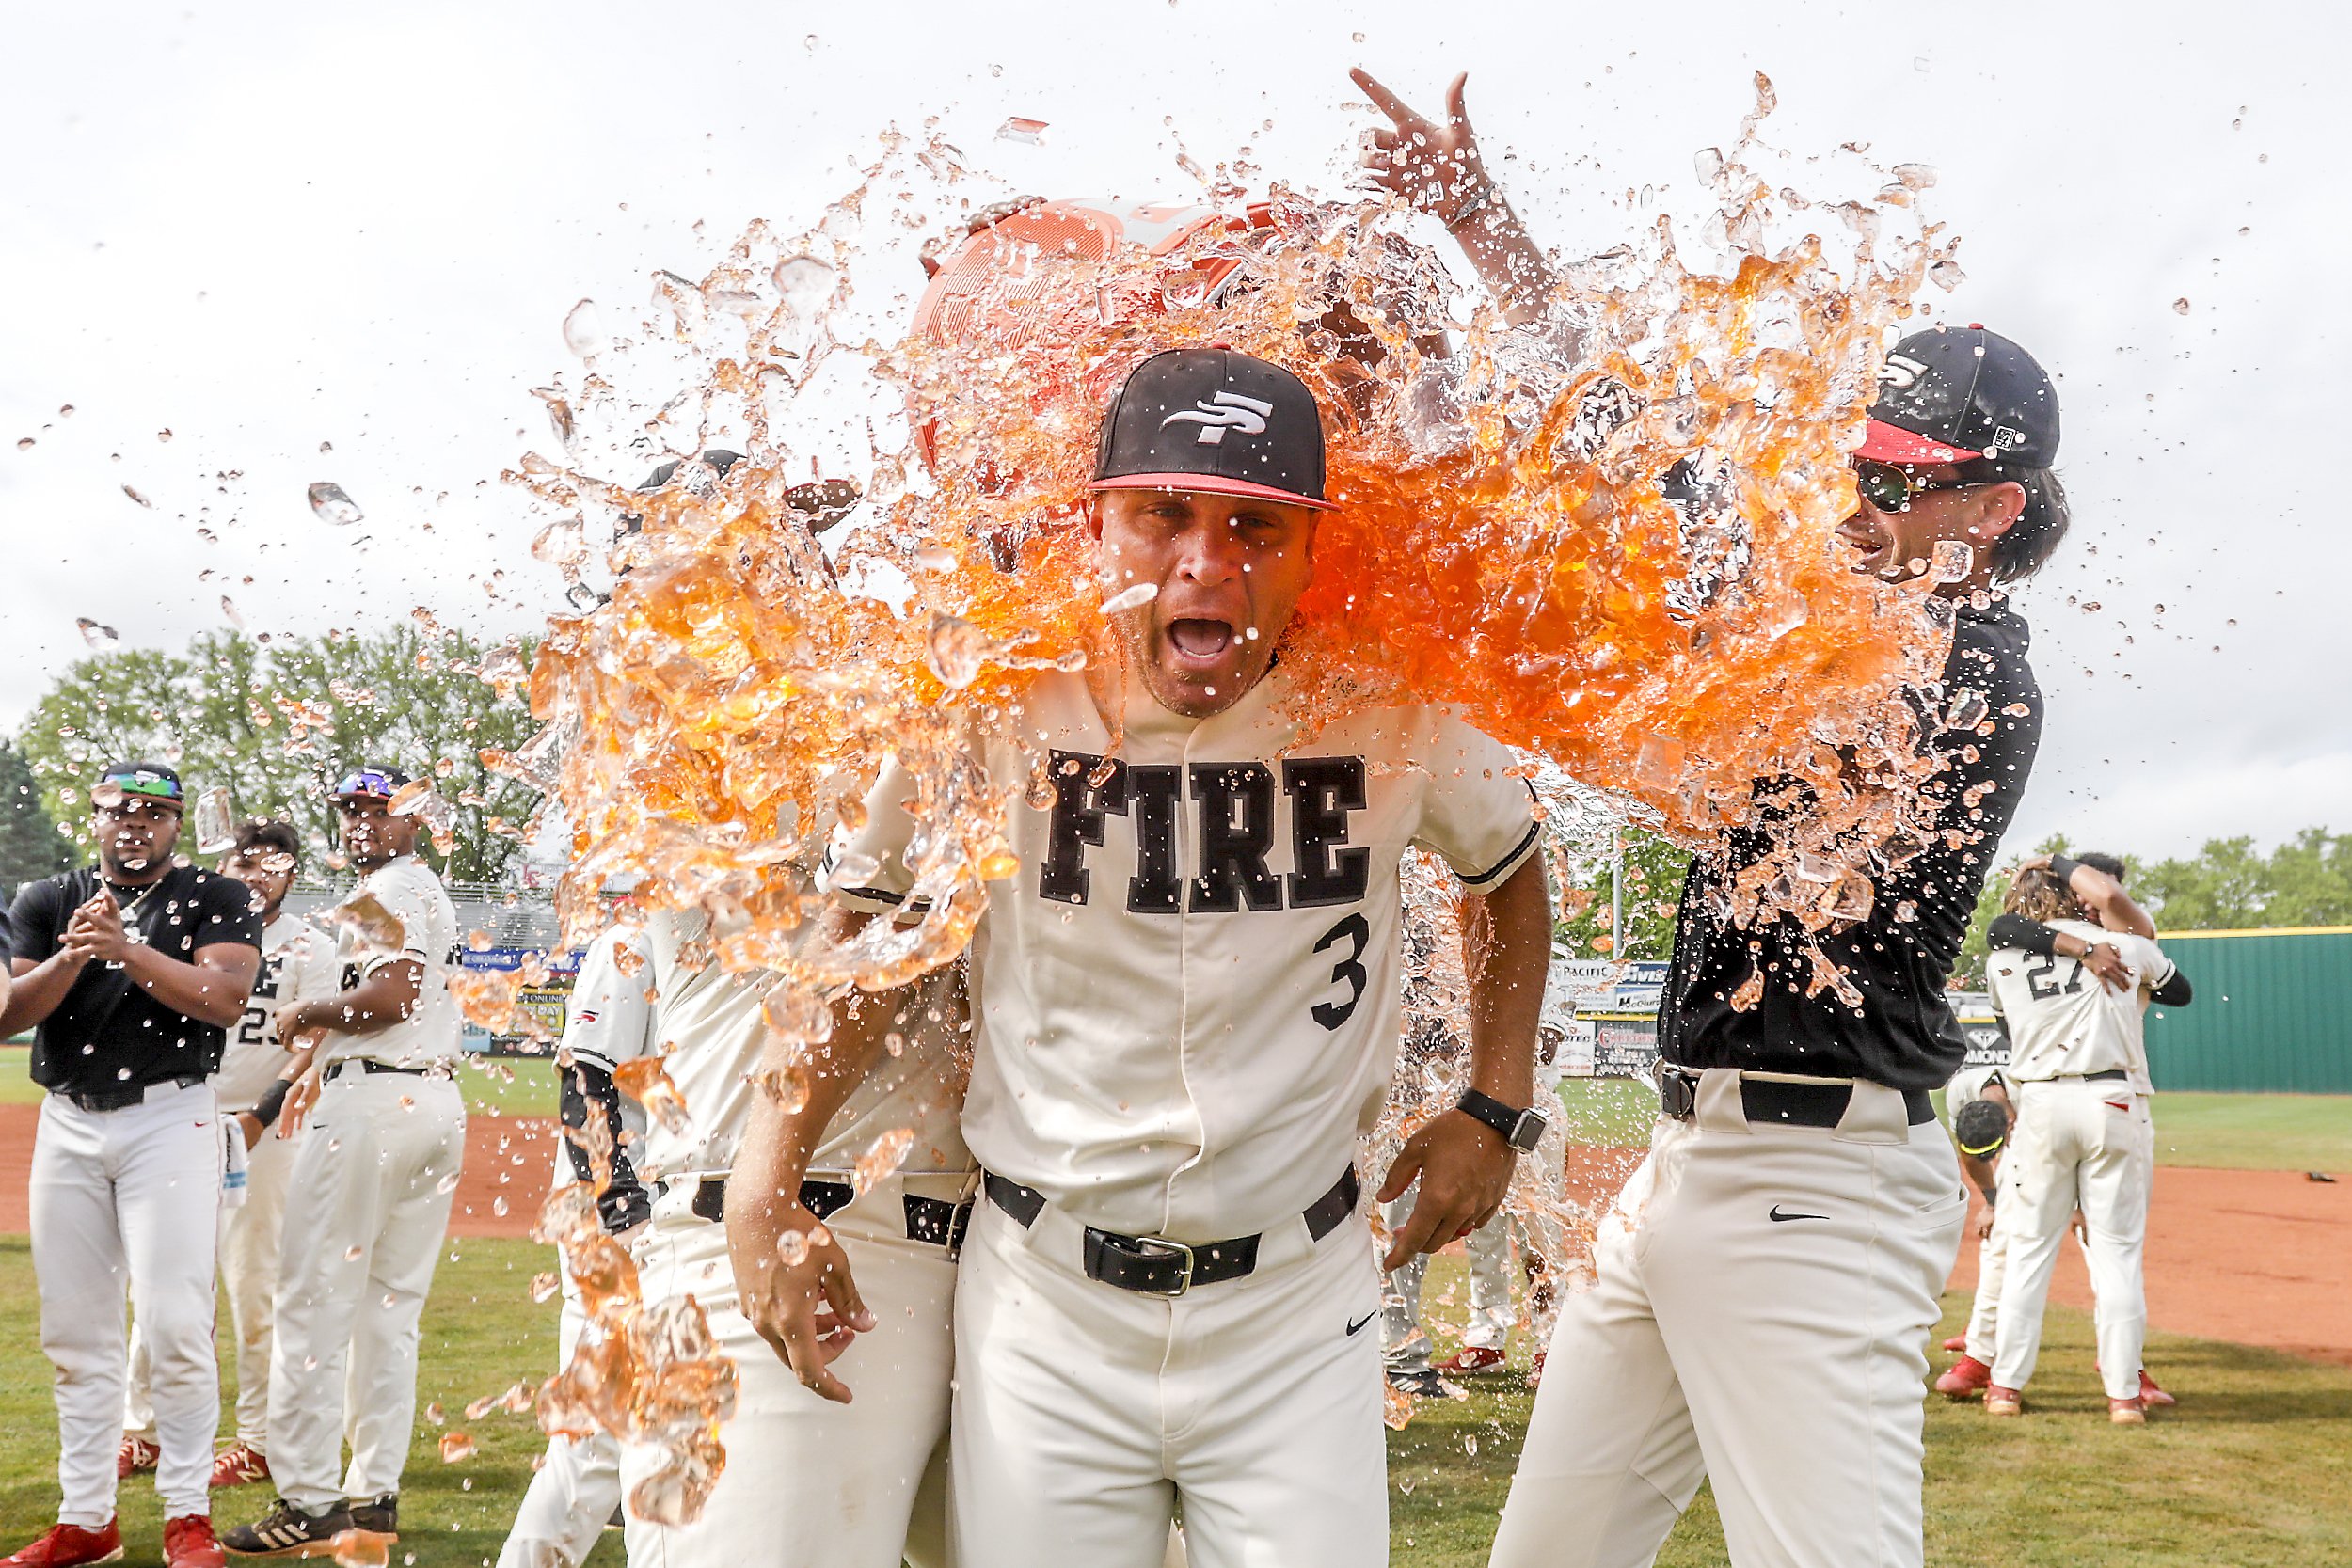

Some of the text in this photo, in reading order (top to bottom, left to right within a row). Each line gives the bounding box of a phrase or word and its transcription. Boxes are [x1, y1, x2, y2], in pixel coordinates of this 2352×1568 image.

[1040, 749, 1371, 914] FIRE
[1311, 911, 1370, 1032] 3
[1564, 966, 1608, 977] PACIFIC
[2023, 949, 2084, 1001] 27
[238, 1007, 282, 1046] 2
